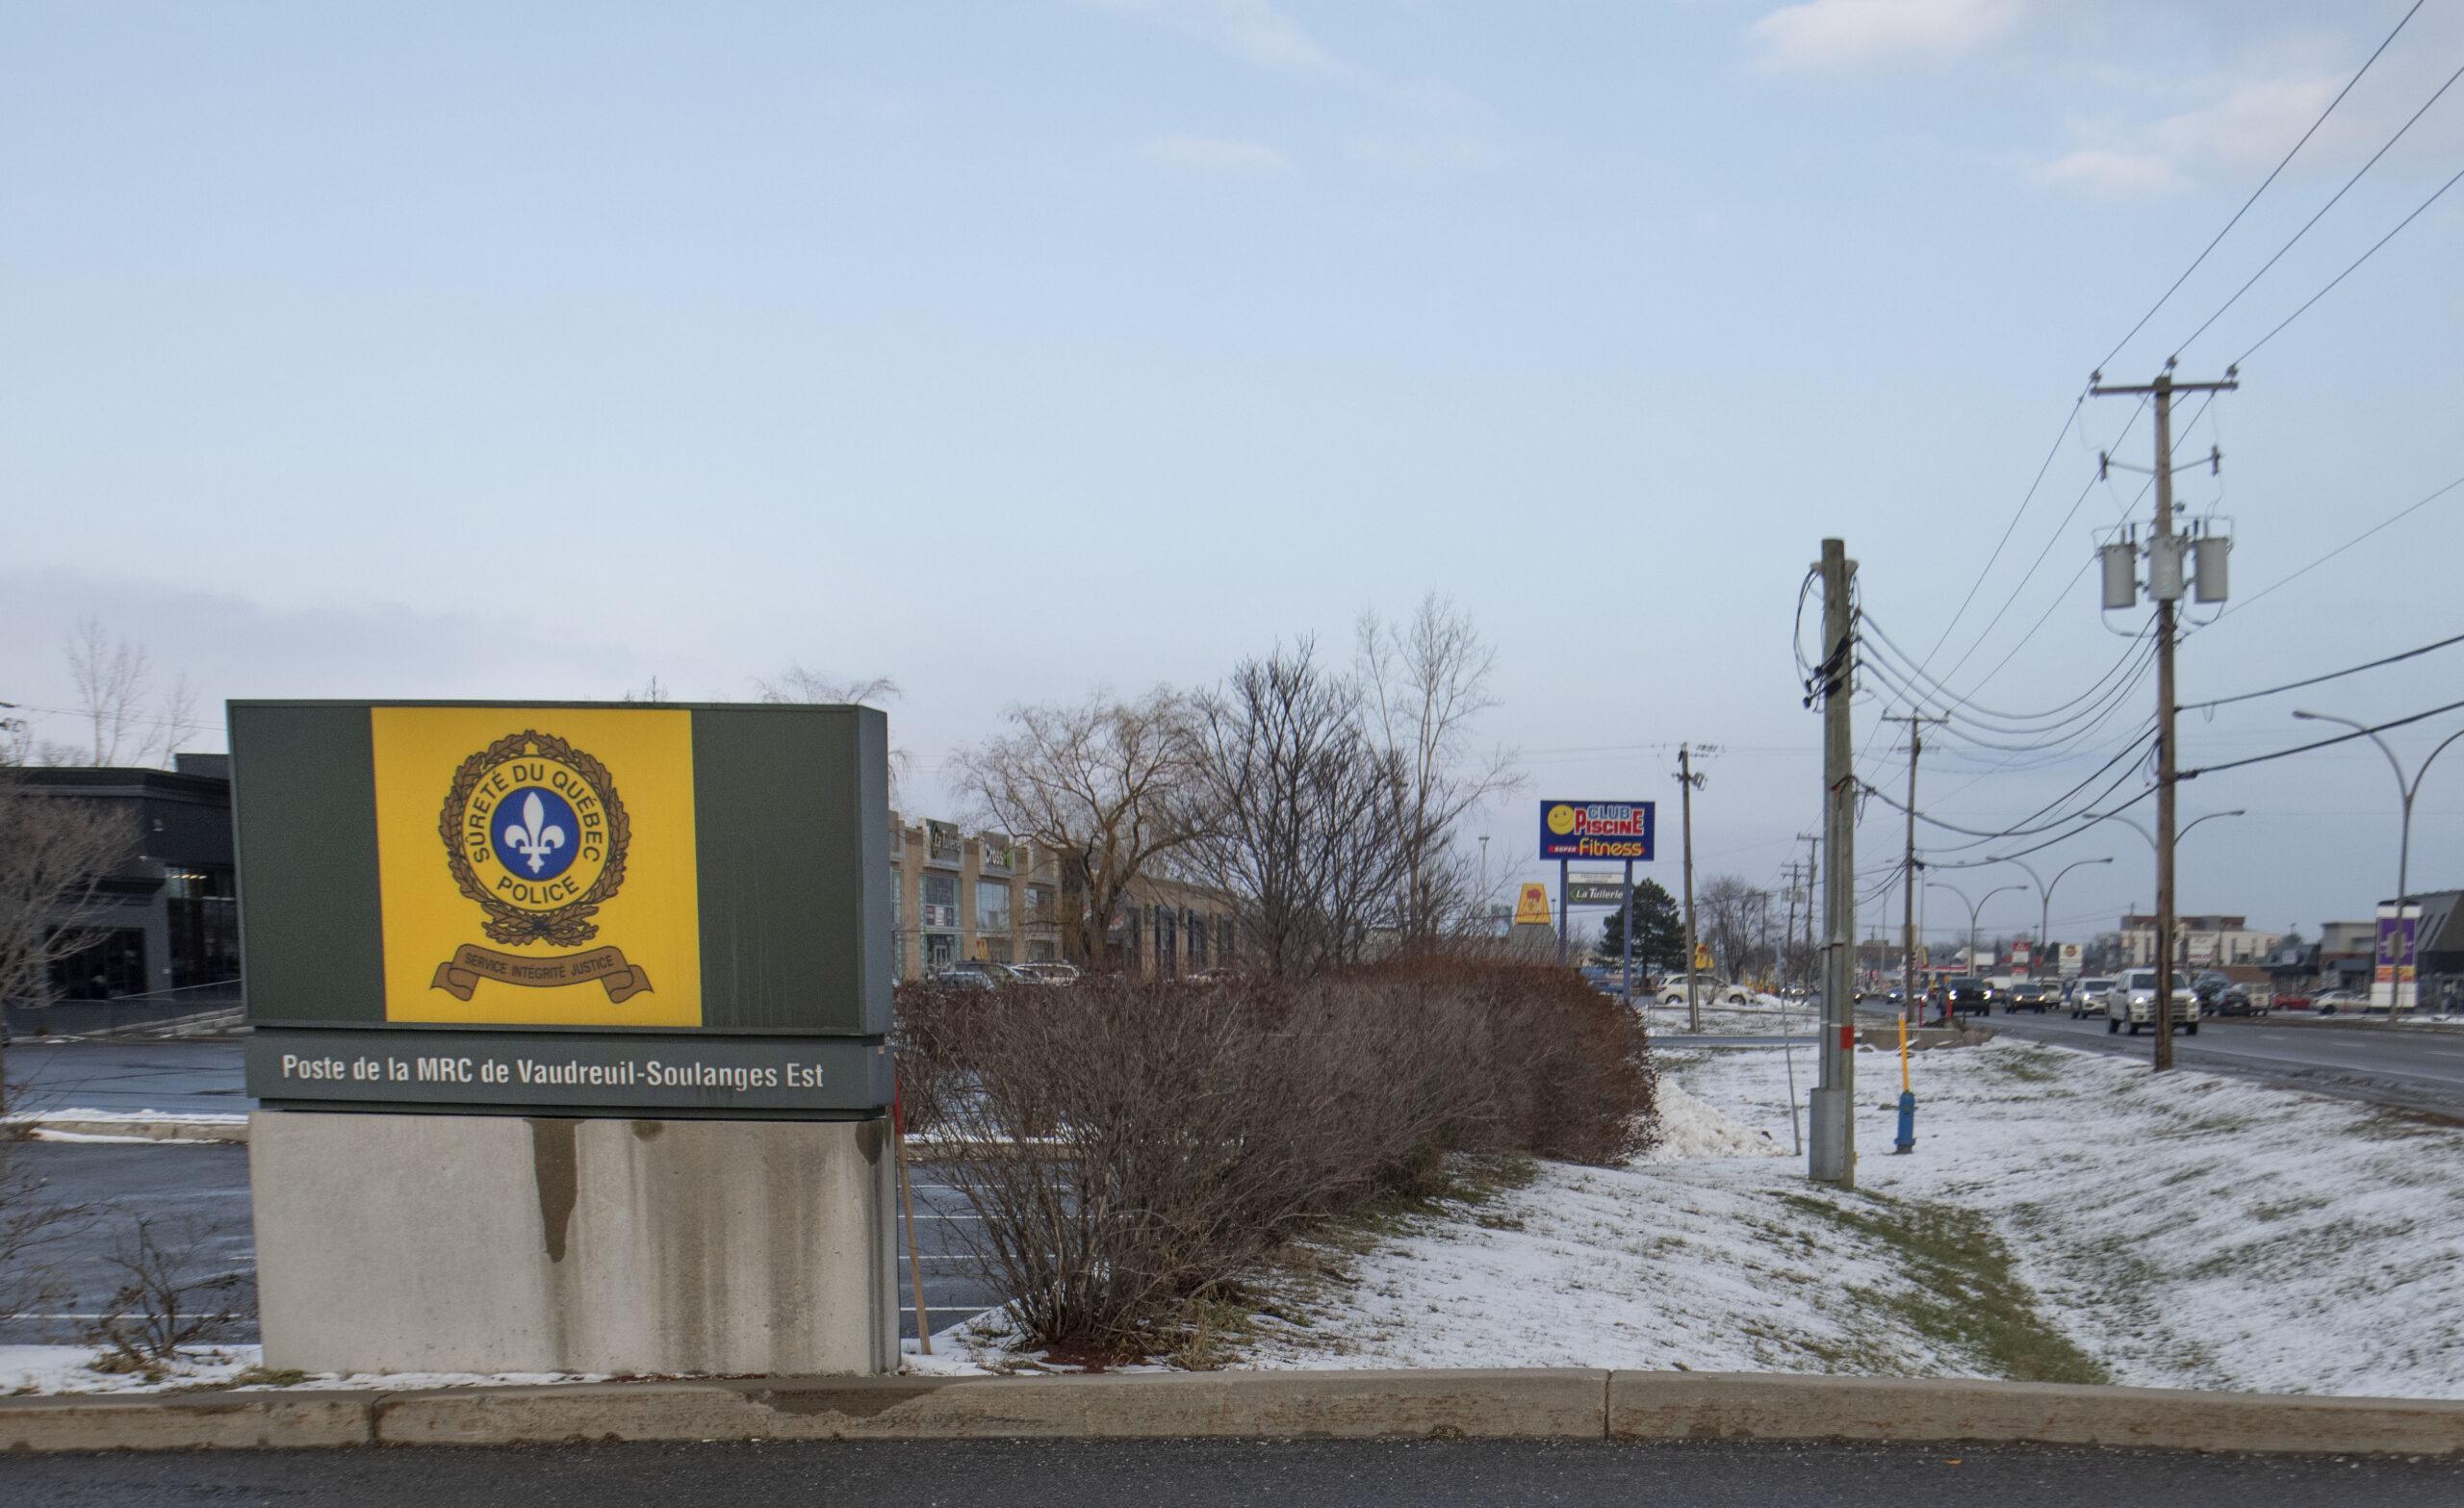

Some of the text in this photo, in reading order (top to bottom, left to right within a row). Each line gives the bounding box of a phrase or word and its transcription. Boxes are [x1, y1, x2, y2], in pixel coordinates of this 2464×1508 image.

[466, 764, 603, 863] SÛRETÉ DU QUÉBEC
[1575, 807, 1644, 835] PISCINE
[1587, 805, 1630, 820] CLUB
[497, 875, 580, 905] POLICE
[1576, 889, 1588, 899] La
[465, 953, 507, 974] SERVICE
[570, 955, 614, 976] JUSTICE
[283, 1055, 824, 1092] Poste de la MRC de Vaudreuil-Soulanges Est
